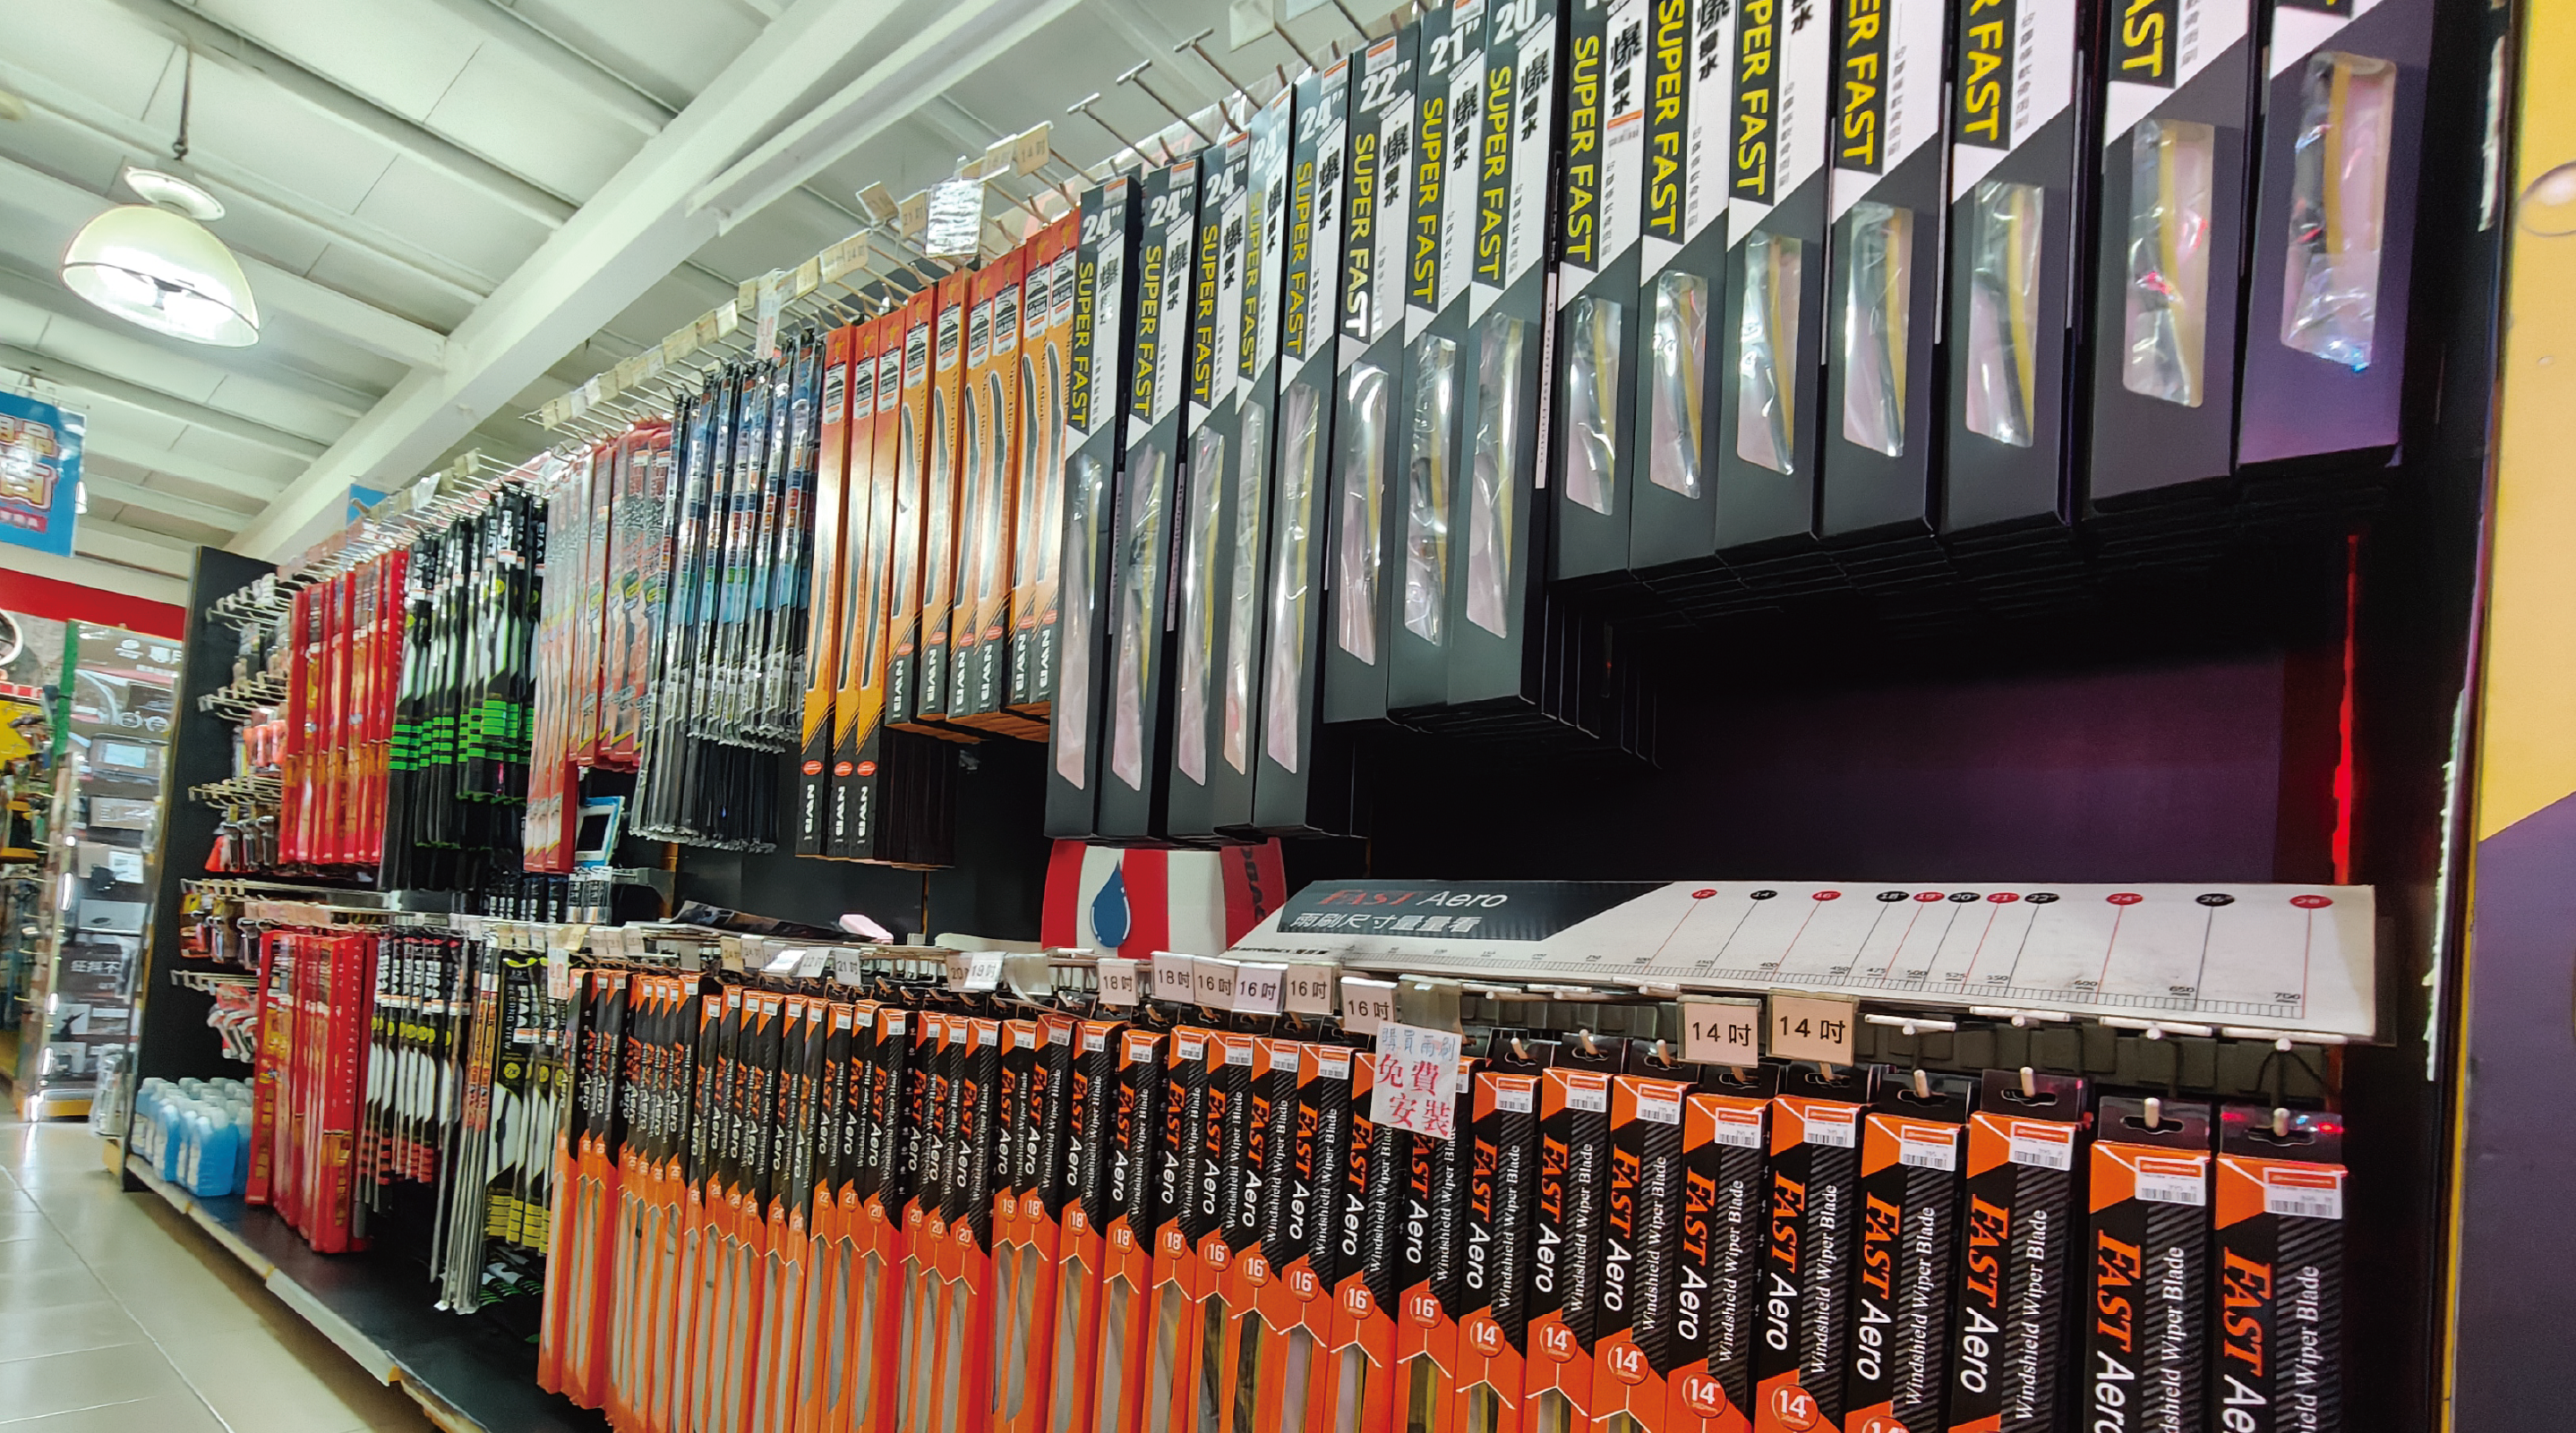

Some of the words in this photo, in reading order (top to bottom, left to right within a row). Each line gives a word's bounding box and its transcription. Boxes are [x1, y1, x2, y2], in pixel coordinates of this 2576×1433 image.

[1654, 0, 1686, 126] SUPER
[1741, 0, 1774, 82] PER
[2121, 0, 2165, 77] ST
[1359, 59, 1412, 113] 22"
[1570, 36, 1600, 158] SUPER
[1843, 53, 1879, 166] FAST
[1964, 20, 2004, 141] FAST
[1417, 98, 1444, 208] SUPER
[1483, 66, 1511, 181] SUPER
[1736, 88, 1769, 196] FAST
[1150, 186, 1193, 227] 24"
[1205, 160, 1246, 208] 24"
[1290, 162, 1313, 263] SUPER
[1353, 133, 1375, 241] SUPER
[1567, 164, 1594, 263] FAST
[1650, 131, 1681, 235] FAST
[1082, 206, 1123, 245] 24"
[1243, 191, 1262, 294] SUPER
[1412, 214, 1437, 304] FAST
[1477, 187, 1504, 280] FAST
[1074, 262, 1094, 349] SUPER
[1140, 246, 1162, 336] SUPER
[1197, 224, 1219, 320] SUPER
[1346, 249, 1371, 338] FAST
[1239, 296, 1257, 372] FAST
[1286, 271, 1307, 354] FAST
[1071, 356, 1090, 428] FAST
[1134, 343, 1155, 417] FAST
[1194, 326, 1212, 402] FAST
[1319, 889, 1416, 906] FAST
[1416, 891, 1508, 908] Aero
[1103, 976, 1133, 993] 18吋
[1159, 969, 1191, 989] 18吋
[1198, 975, 1233, 996] 16吋
[1240, 981, 1277, 1001] 16吋
[1290, 980, 1328, 1000] 16吋
[1348, 1000, 1390, 1021] 16吋
[1692, 1021, 1752, 1047] 14吋
[1779, 1015, 1846, 1045] 14吋
[1031, 1063, 1048, 1122] FAST
[1072, 1071, 1088, 1135] FAST
[1376, 1053, 1440, 1096] 免費
[1117, 1081, 1134, 1147] FAST
[1167, 1080, 1185, 1148] FAST
[1207, 1087, 1226, 1156] FAST
[1248, 1095, 1270, 1169] FAST
[1296, 1101, 1318, 1180] FAST
[1389, 1092, 1451, 1138] 安裝
[1024, 1126, 1041, 1175] Aero
[1066, 1135, 1083, 1186] Aero
[1112, 1149, 1129, 1201] Aero
[1161, 1150, 1179, 1204] Aero
[1349, 1113, 1374, 1193] FAST
[1375, 1161, 1391, 1197] Wiper
[1411, 1136, 1434, 1196] AST
[1472, 1137, 1497, 1220] FAST
[1506, 1145, 1520, 1184] Blade
[1541, 1135, 1568, 1224] FAST
[1578, 1143, 1593, 1184] Blade
[1651, 1156, 1666, 1198] Blade
[1202, 1158, 1220, 1215] Aero
[1242, 1169, 1262, 1227] Aero
[1289, 1180, 1311, 1240] Aero
[1440, 1166, 1456, 1212] Wiper
[1503, 1187, 1519, 1227] Wiper
[1576, 1187, 1593, 1229] Wiper
[1610, 1146, 1640, 1239] FAST
[1683, 1168, 1716, 1267] FAST
[1728, 1180, 1744, 1224] Blade
[1819, 1184, 1837, 1230] Blade
[1341, 1193, 1365, 1256] Aero
[1369, 1200, 1387, 1272] Windshield
[1406, 1199, 1429, 1264] Aero
[1436, 1212, 1451, 1281] Windshield
[1467, 1222, 1491, 1289] Aero
[1647, 1200, 1666, 1245] Wiper
[1724, 1226, 1743, 1273] Wiper
[1771, 1172, 1806, 1274] FAST
[1816, 1233, 1837, 1280] Wiper
[1863, 1191, 1900, 1301] FAST
[1915, 1207, 1935, 1255] Blade
[1967, 1193, 2009, 1309] FAST
[2025, 1209, 2048, 1260] Blade
[1498, 1231, 1514, 1308] Windshield
[1535, 1223, 1562, 1292] Aero
[1570, 1233, 1588, 1311] Windshield
[1604, 1238, 1632, 1311] Aero
[1642, 1250, 1660, 1331] Windshield
[1912, 1258, 1935, 1308] Wiper
[2022, 1263, 2047, 1315] Wiper
[2097, 1230, 2141, 1352] FAST
[2162, 1247, 2185, 1301] Blade
[1678, 1265, 1707, 1340] Aero
[1718, 1277, 1737, 1361] Windshield
[1766, 1272, 1798, 1351] Aero
[2223, 1247, 2271, 1377] FAST
[2295, 1266, 2320, 1322] Blade
[1810, 1285, 1831, 1373] Windshield
[1857, 1298, 1892, 1381] Aero
[1905, 1313, 1929, 1404] Windshield
[1960, 1306, 1999, 1393] Aero
[2160, 1305, 2186, 1360] Wiper
[2294, 1326, 2323, 1385] Wiper
[2015, 1321, 2040, 1419] Windshield
[2158, 1368, 2181, 1433] dshield
[2222, 1374, 2267, 1433] Ae
